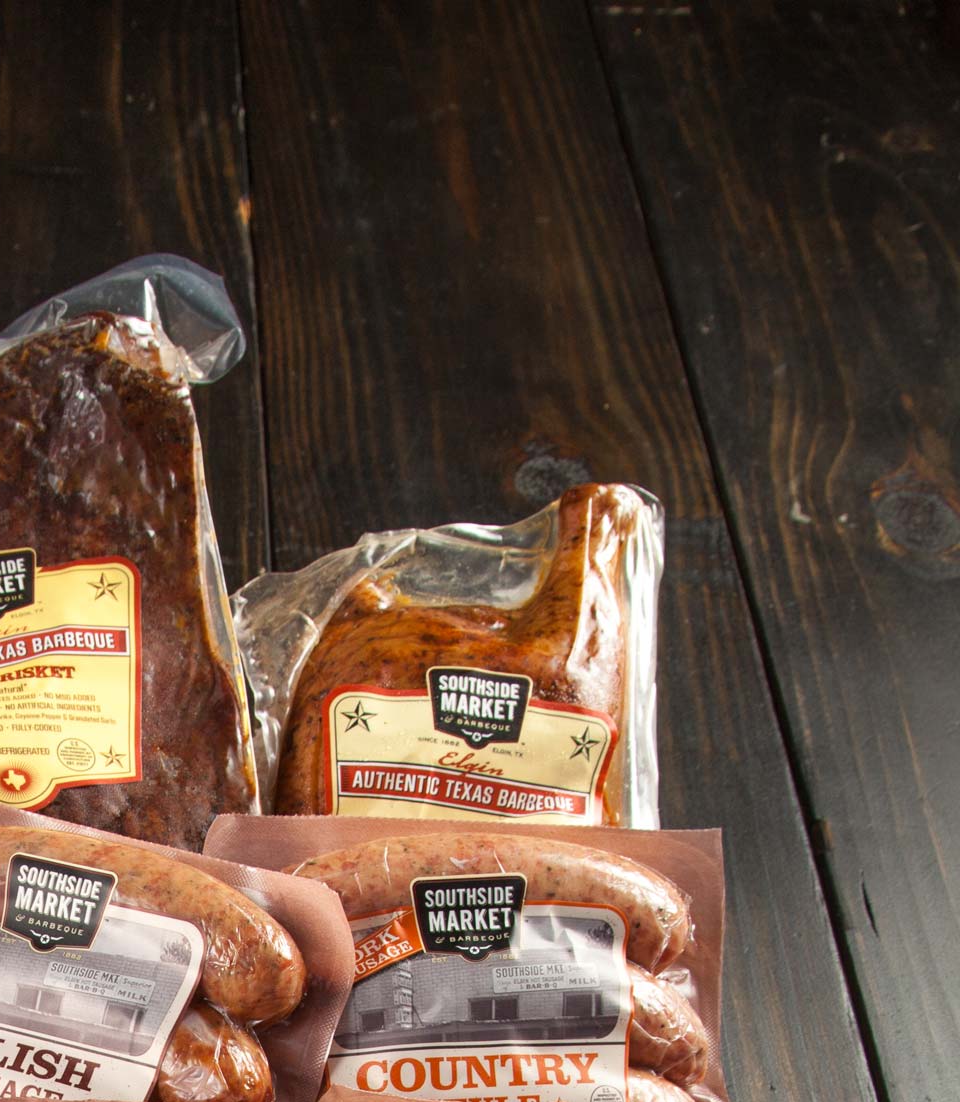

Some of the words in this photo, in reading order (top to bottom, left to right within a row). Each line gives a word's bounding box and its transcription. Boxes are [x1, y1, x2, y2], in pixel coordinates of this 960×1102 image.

[32, 628, 115, 652] BARBEQUE
[439, 674, 520, 700] SOUTHSIDE
[441, 692, 518, 720] MARKET
[457, 719, 511, 731] BARBEQUE
[438, 752, 504, 776] Elgin
[352, 770, 440, 796] AUTHENTIC
[445, 780, 491, 804] TEXAS
[498, 791, 574, 812] BARBEQUE
[18, 865, 102, 900] SOUTHSIDE
[14, 886, 96, 925] MARKET
[424, 886, 514, 908] SOUTHSIDE
[29, 918, 84, 936] BARBEQUE
[428, 908, 512, 932] MARKET
[355, 925, 400, 962] ORK
[450, 932, 510, 942] BARBEQUE
[355, 940, 413, 974] USAGE
[51, 963, 100, 979] SOUTHSIDE
[496, 967, 543, 978] SOUTHSIDE
[356, 1052, 598, 1092] COUNTRY
